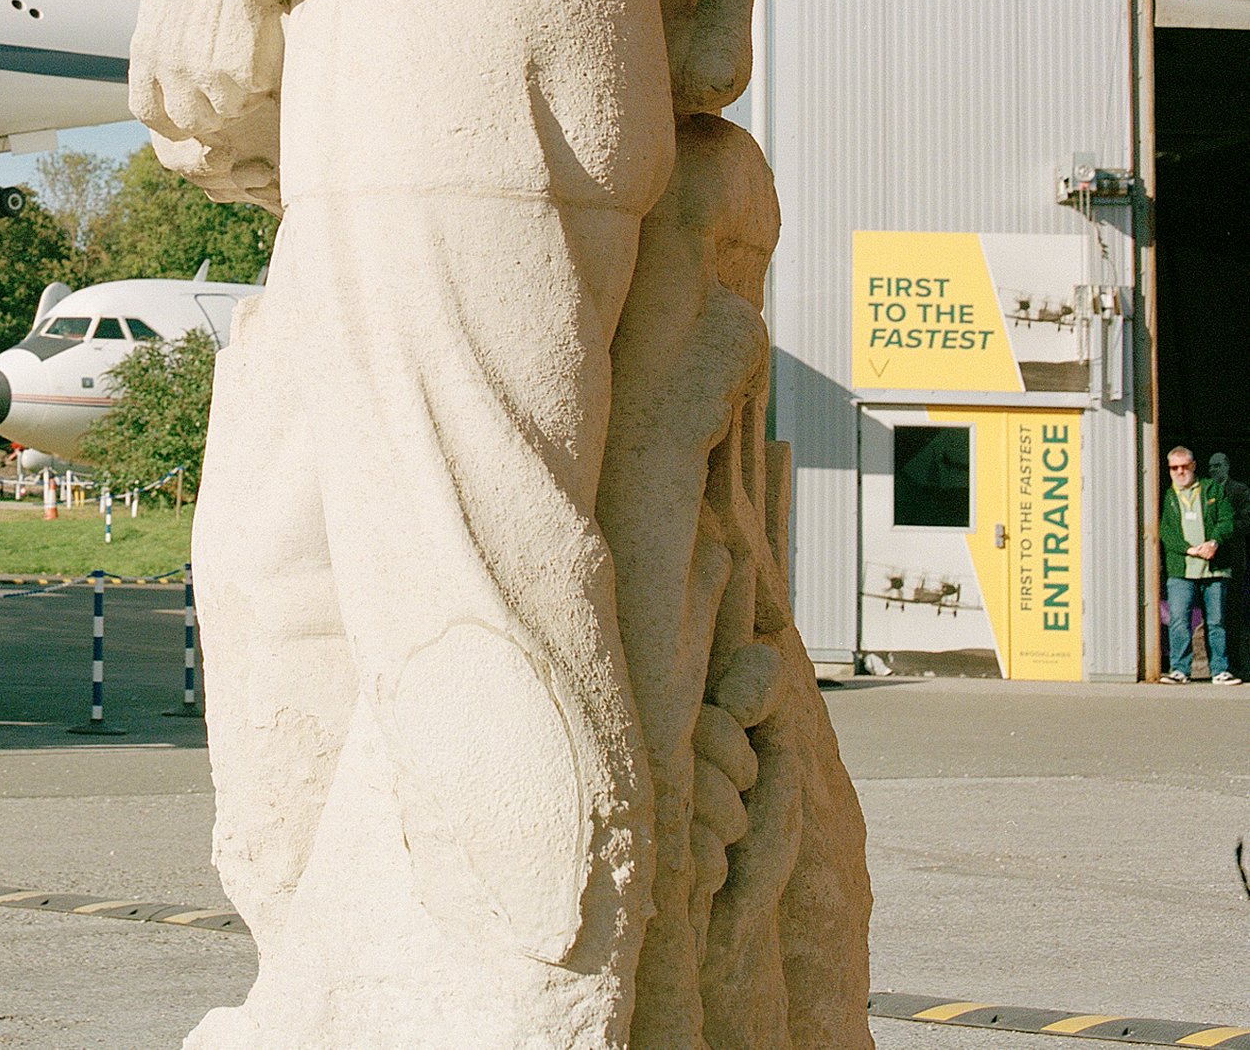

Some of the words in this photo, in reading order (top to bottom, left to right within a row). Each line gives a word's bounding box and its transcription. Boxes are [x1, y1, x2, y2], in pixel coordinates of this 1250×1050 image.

[869, 277, 950, 298] FIRST
[868, 303, 906, 323] TO
[916, 304, 974, 324] THE
[869, 328, 995, 350] FASTEST
[1019, 424, 1033, 496] FASTEST
[1020, 502, 1033, 533] THE
[1042, 424, 1070, 631] ENTRANCE
[1020, 538, 1033, 560] TO
[1020, 566, 1033, 611] FIRST
